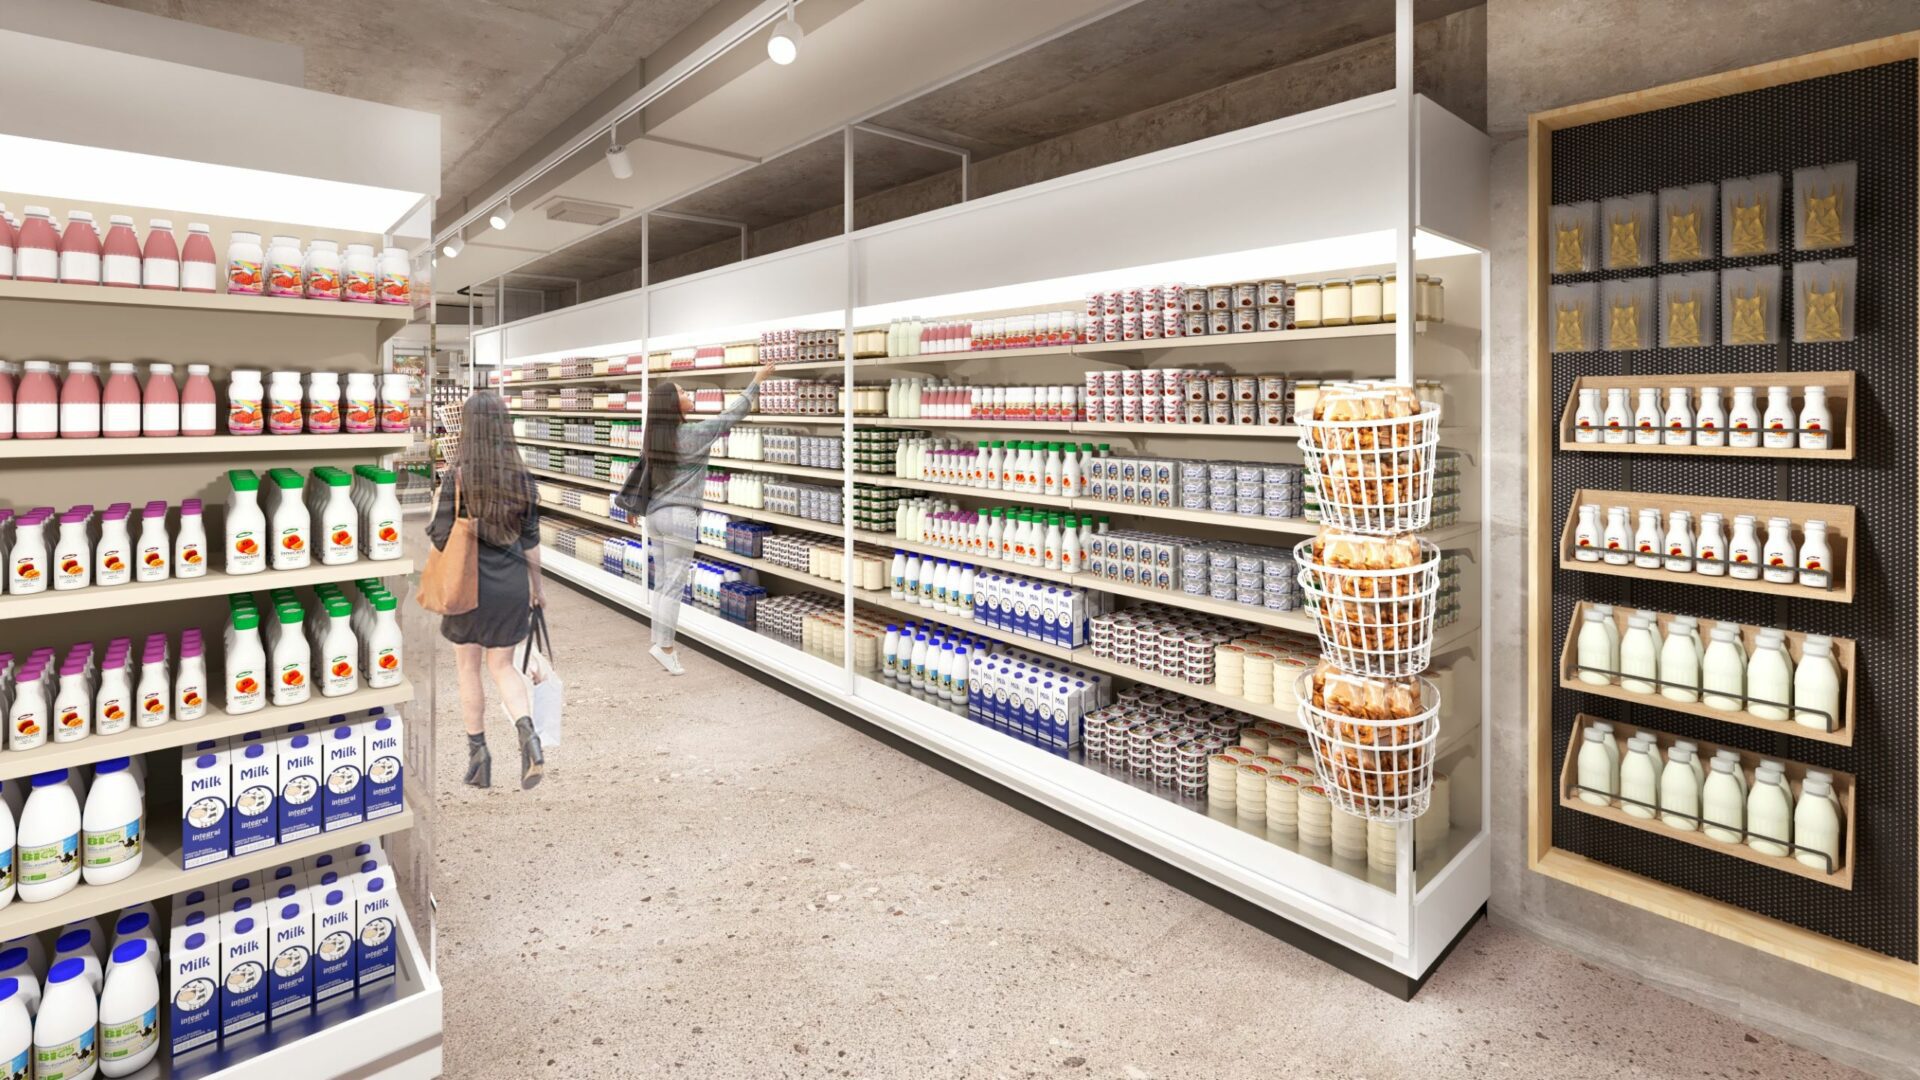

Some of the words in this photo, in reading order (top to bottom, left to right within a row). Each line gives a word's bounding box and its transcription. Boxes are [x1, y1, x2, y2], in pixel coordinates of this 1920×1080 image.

[372, 737, 397, 750] Milk
[331, 746, 357, 760] Milk
[287, 756, 314, 770] Milk
[240, 765, 269, 780] Milk
[191, 776, 222, 791] Milk
[373, 784, 396, 796] integral
[331, 794, 356, 806] integral
[287, 805, 314, 817] integral
[241, 816, 269, 829] integral
[192, 829, 221, 841] integral
[364, 898, 389, 914] Milk
[322, 911, 349, 928] Milk
[277, 925, 305, 942] Milk
[230, 940, 259, 958] Milk
[364, 946, 389, 959] integral
[180, 956, 211, 974] Milk
[323, 960, 348, 974] integral
[278, 975, 304, 990] integral
[231, 992, 258, 1007] integral
[180, 1010, 210, 1024] integral
